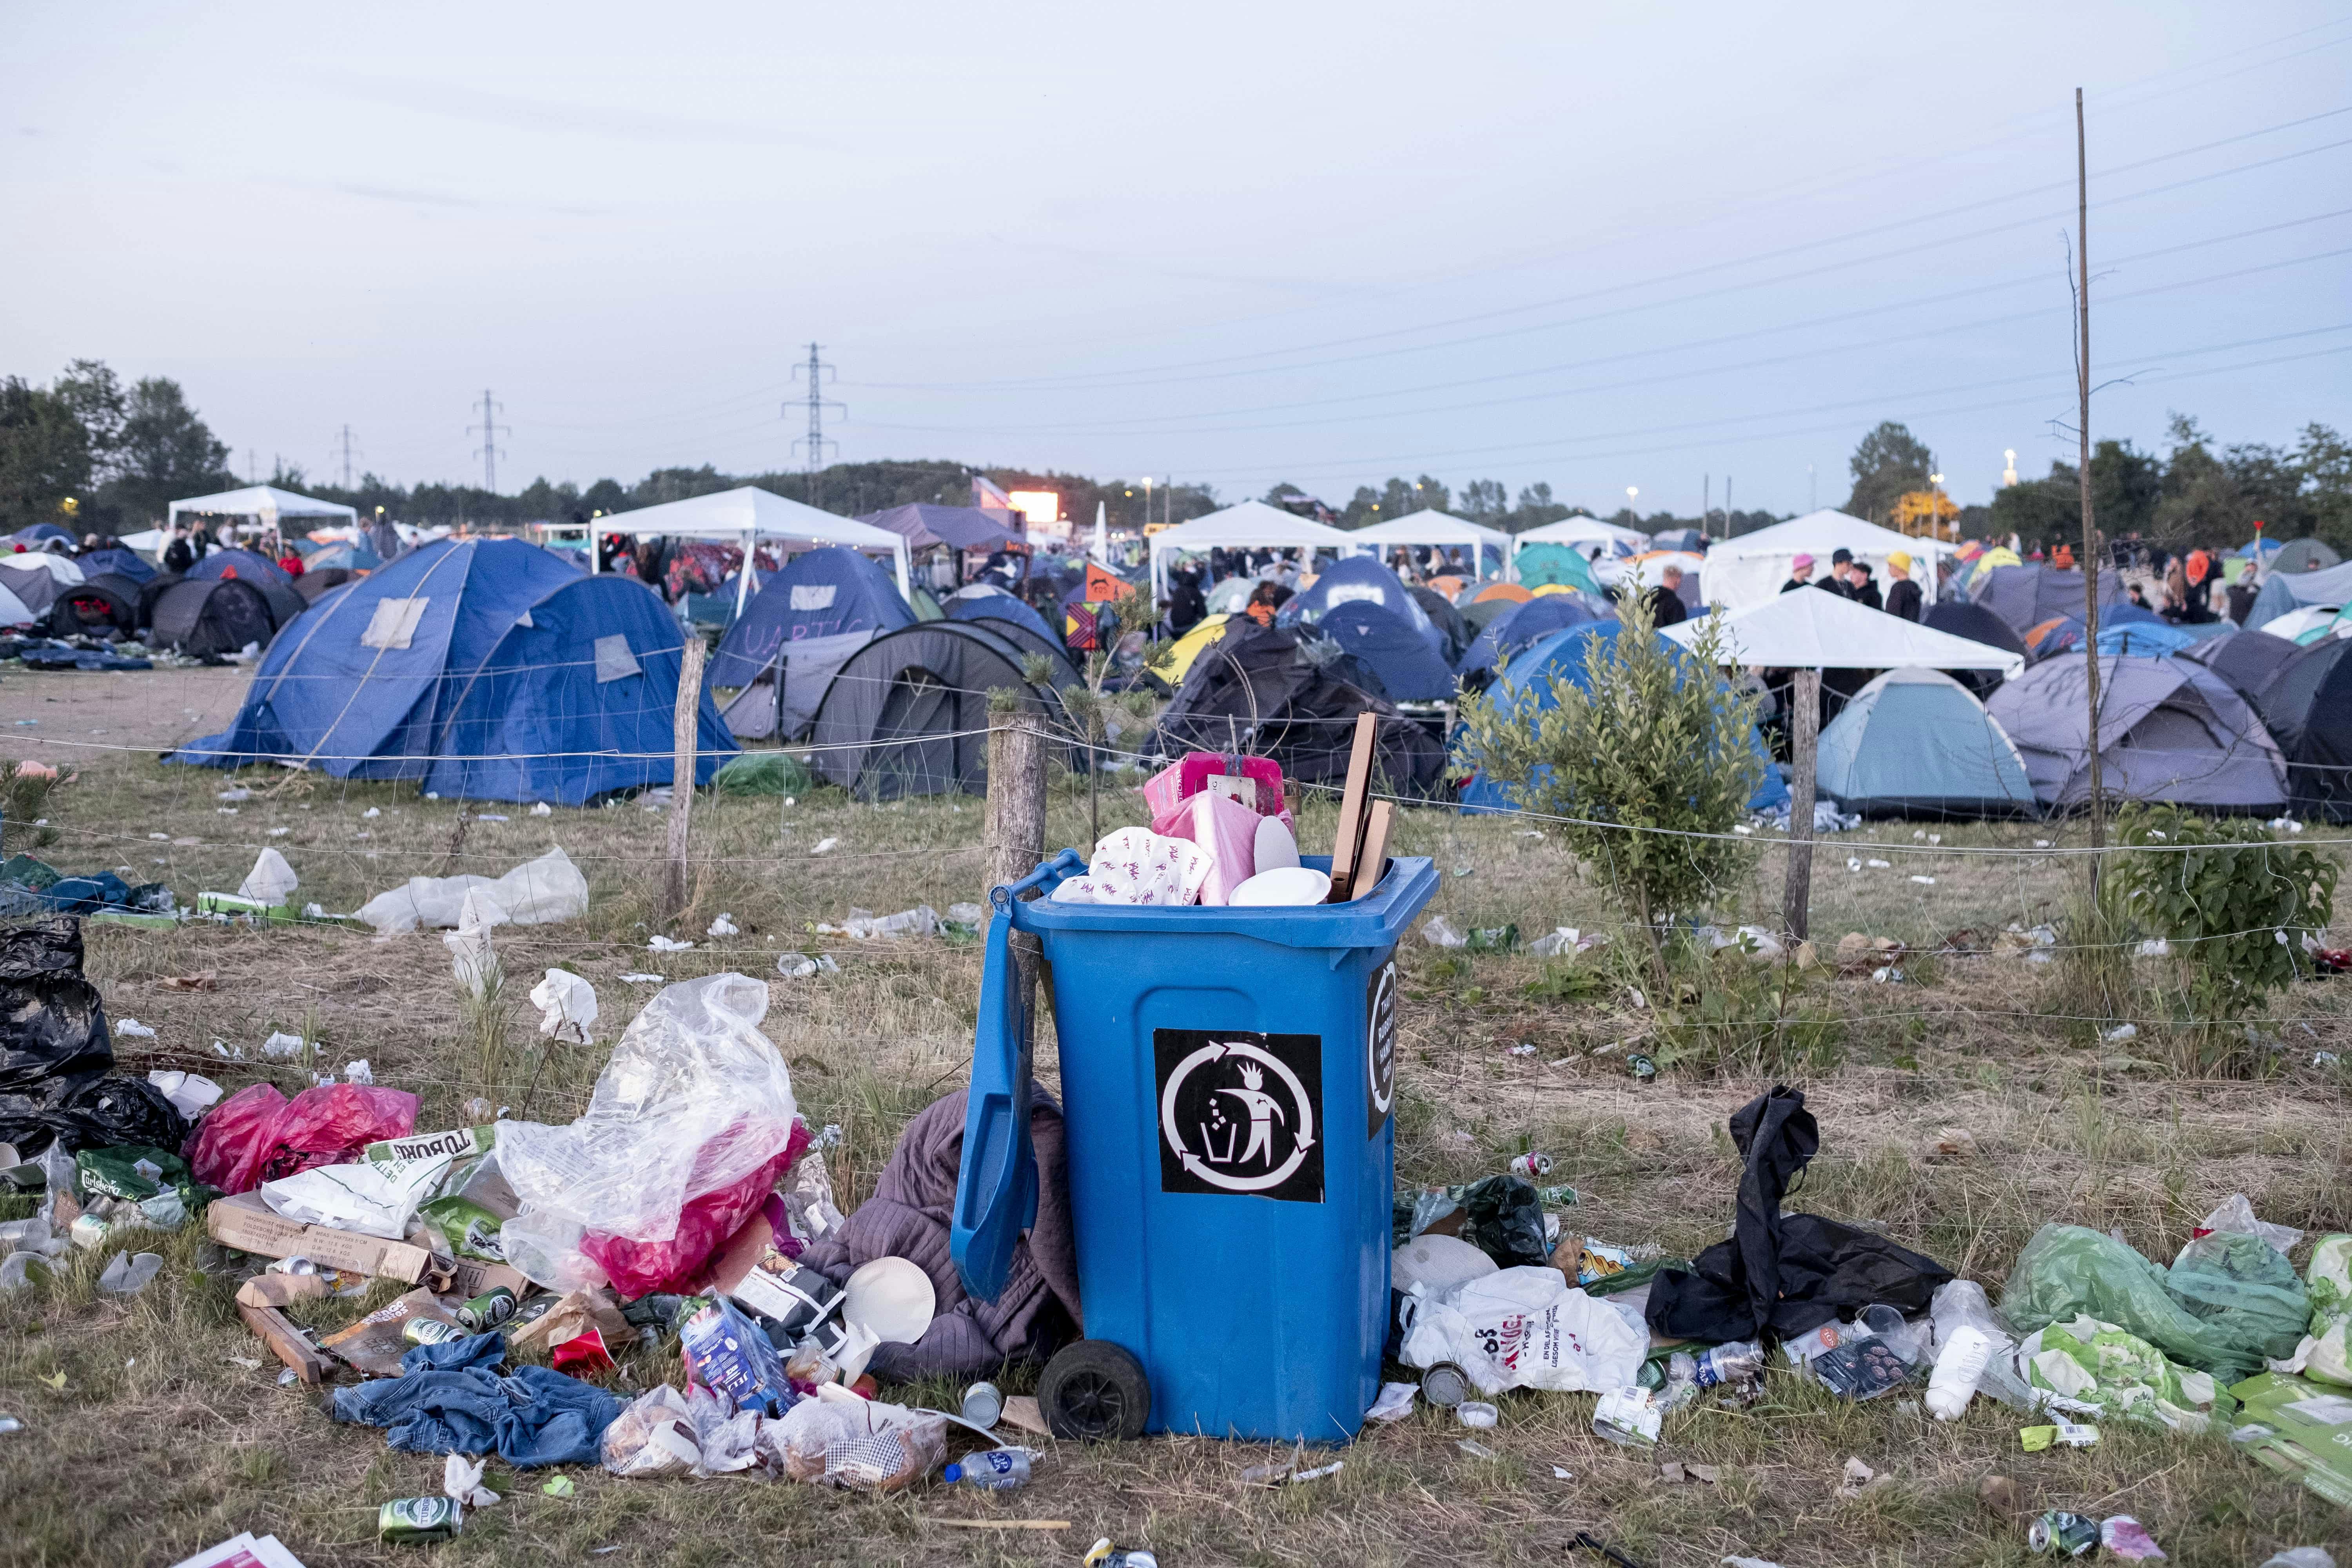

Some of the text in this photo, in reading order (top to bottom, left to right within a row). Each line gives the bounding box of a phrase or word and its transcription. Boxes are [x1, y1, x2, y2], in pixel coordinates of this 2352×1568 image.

[1383, 1058, 1392, 1083] OVER
[67, 1201, 78, 1211] BIO
[244, 1222, 274, 1234] FOLDEBORD
[421, 1498, 431, 1524] TUBOR
